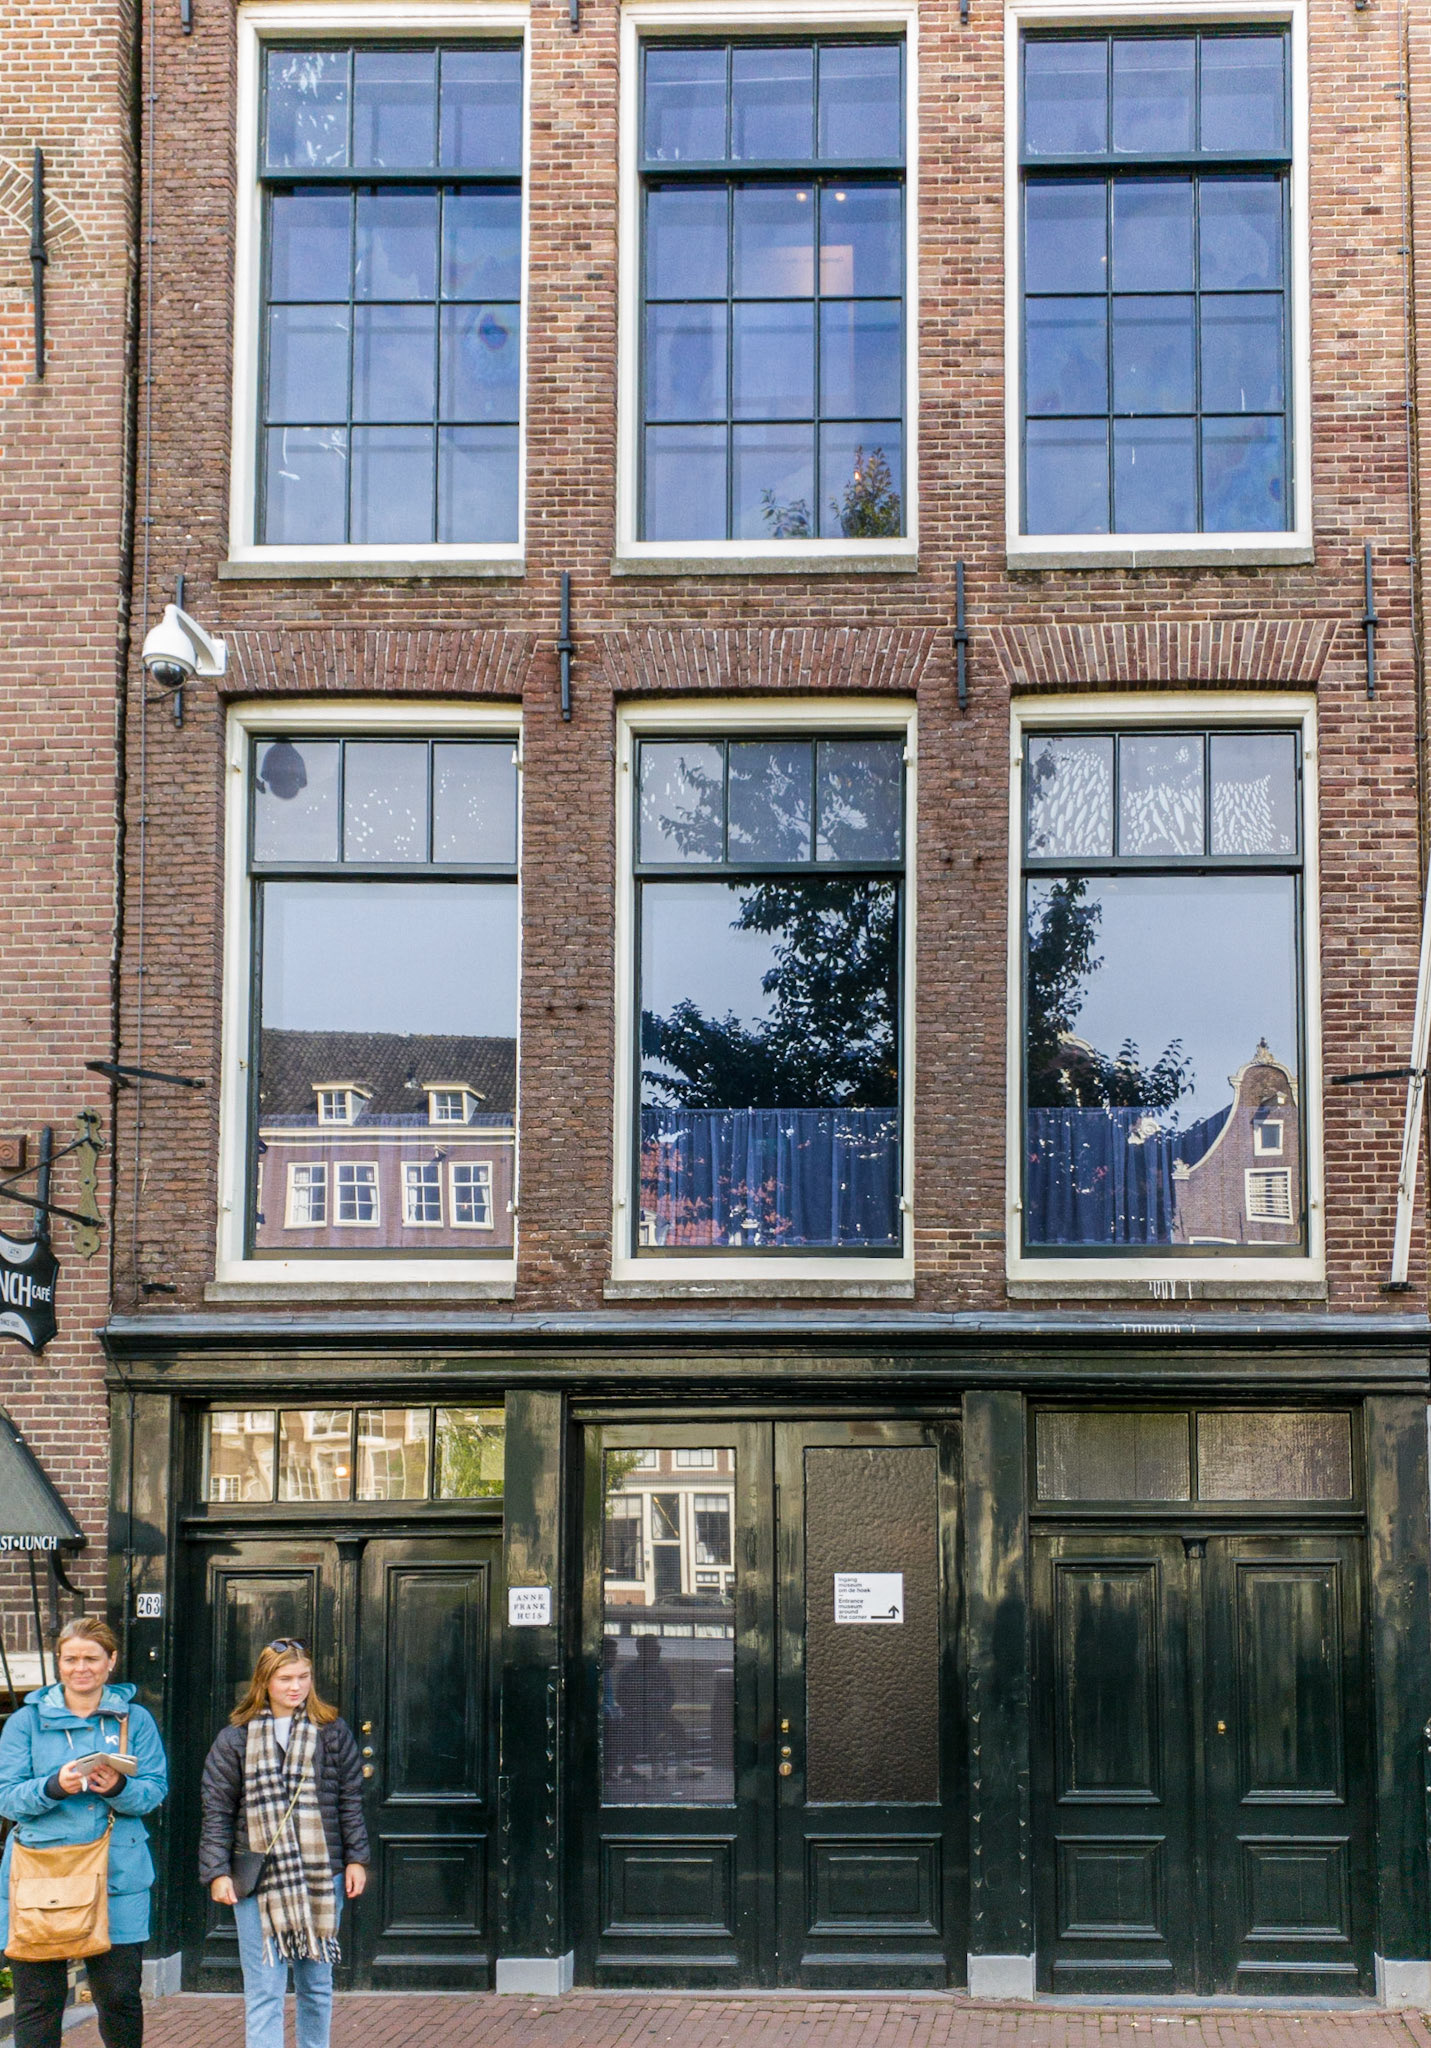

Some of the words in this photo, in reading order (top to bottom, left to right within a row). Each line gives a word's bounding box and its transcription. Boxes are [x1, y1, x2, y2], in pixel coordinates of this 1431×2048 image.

[32, 1285, 51, 1302] CAFÉ
[138, 1596, 160, 1615] 263
[513, 1603, 545, 1611] FRANK
